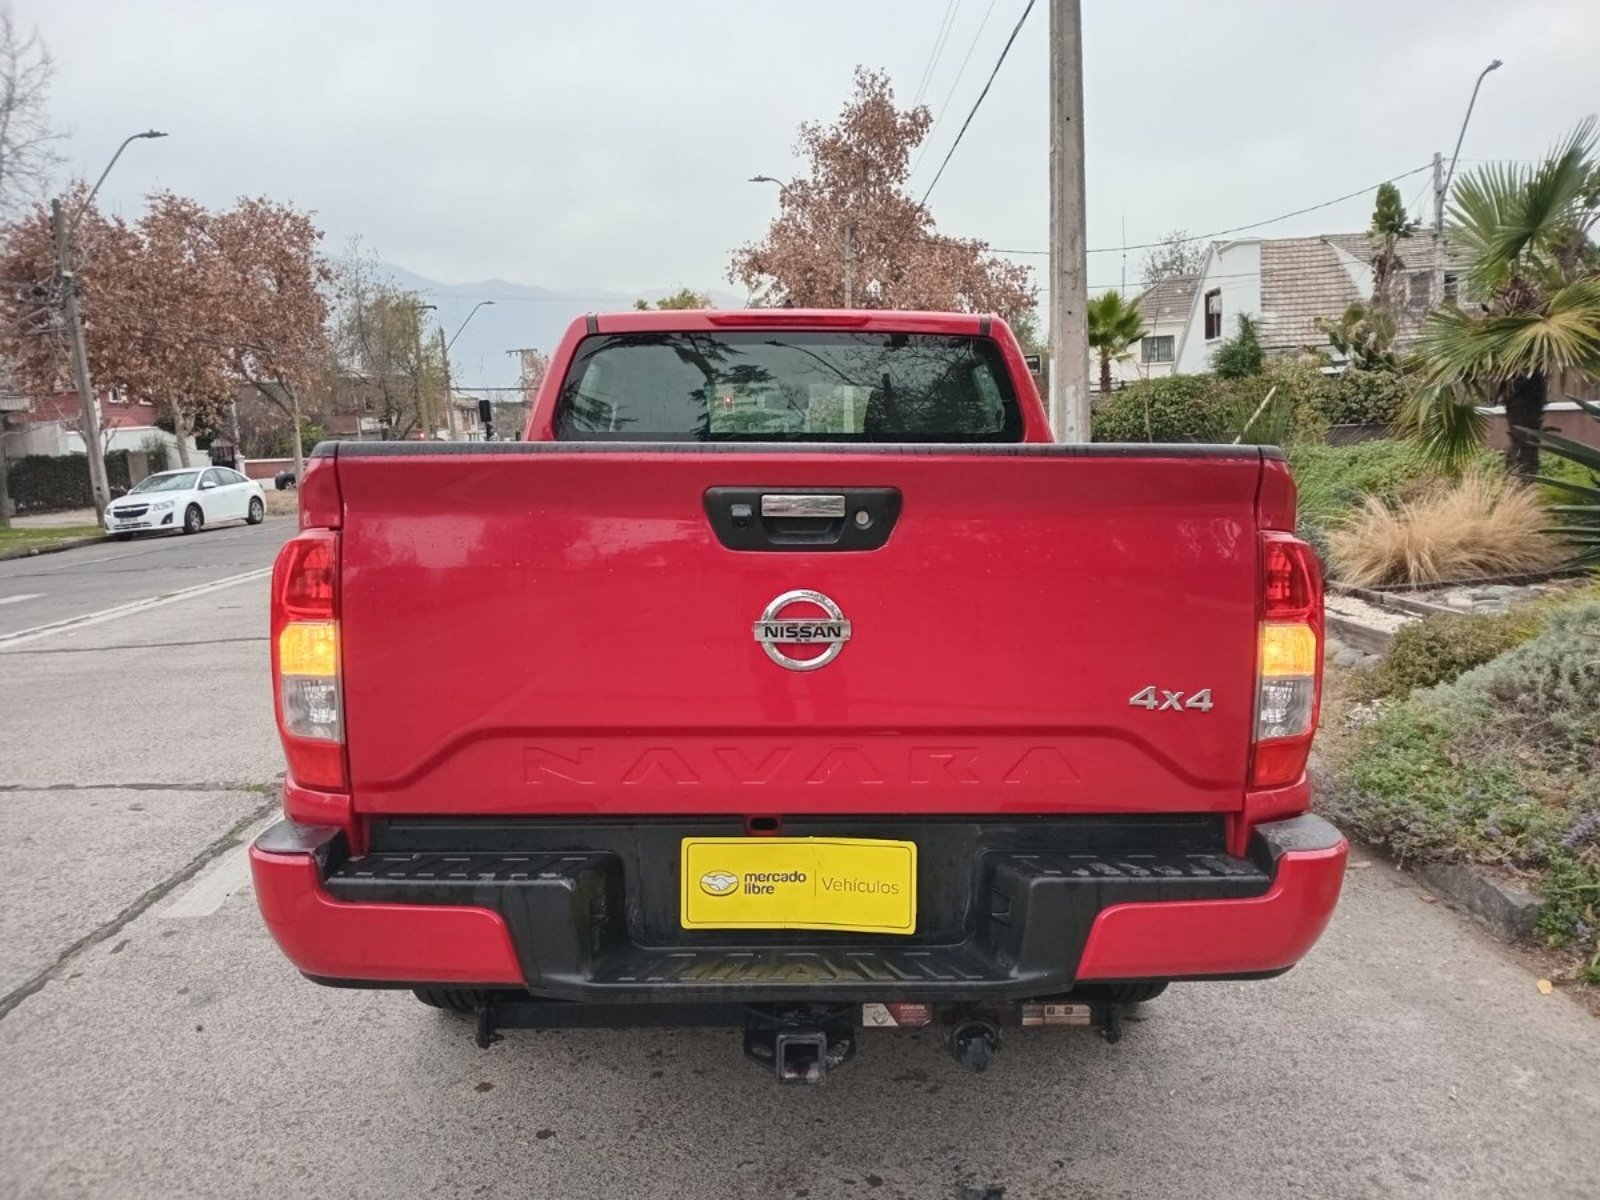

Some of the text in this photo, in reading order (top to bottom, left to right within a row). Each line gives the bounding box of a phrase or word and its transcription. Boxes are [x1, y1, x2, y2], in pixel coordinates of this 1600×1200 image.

[764, 625, 841, 638] NISSAN
[1129, 685, 1214, 712] 4x4
[523, 746, 1082, 785] NAVARA
[744, 870, 806, 883] mercado
[744, 883, 775, 895] libre
[822, 876, 900, 895] Vehículos
